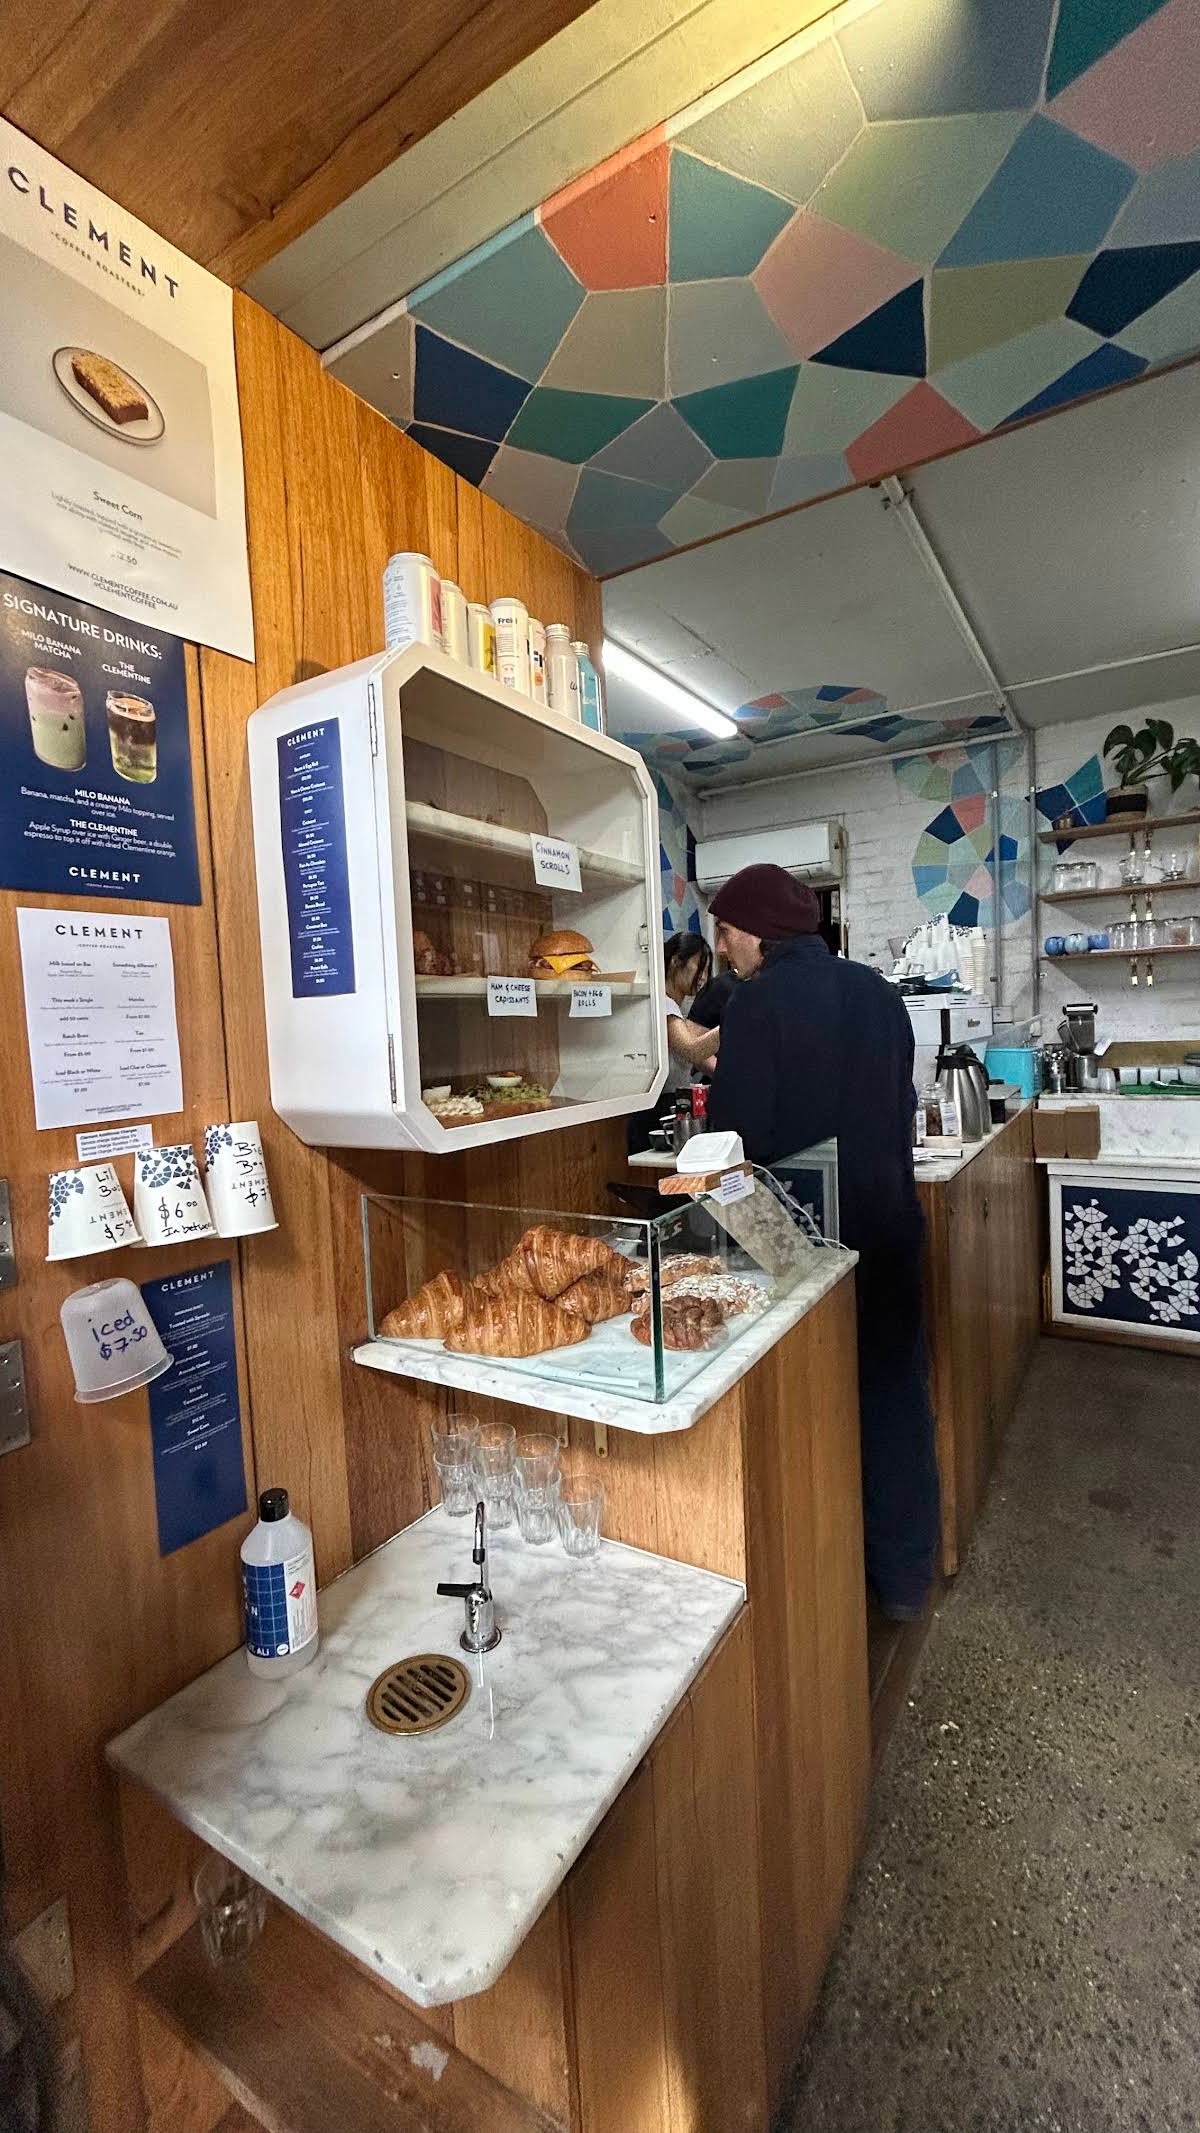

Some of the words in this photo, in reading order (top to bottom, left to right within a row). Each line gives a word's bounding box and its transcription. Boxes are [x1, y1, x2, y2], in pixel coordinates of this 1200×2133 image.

[8, 167, 179, 298] CLEMENT
[93, 491, 119, 511] Sweet
[121, 504, 143, 521] Corn
[3, 592, 101, 639] SIGNATURE
[103, 628, 162, 660] DRINKS:
[22, 629, 45, 643] MILO
[46, 636, 82, 656] BANANA
[34, 641, 72, 660] MATCHA
[102, 663, 151, 685] CLEMENTINE
[119, 661, 135, 672] THE
[287, 727, 325, 747] CLEMENT
[74, 788, 97, 800] MILO
[97, 791, 131, 806] BANANA
[77, 798, 89, 806] and
[95, 801, 117, 812] creamy
[91, 809, 106, 817] over
[29, 821, 51, 832] Apple
[51, 824, 71, 836] Syrup
[72, 829, 86, 837] over
[97, 832, 110, 840] with
[111, 833, 132, 845] Ginger
[69, 818, 88, 830] THE
[88, 821, 138, 837] CLEMENTINE
[24, 830, 54, 841] espresso
[55, 834, 63, 842] to
[63, 835, 75, 845] top
[81, 838, 91, 846] off
[91, 839, 105, 848] with
[105, 841, 121, 850] dried
[69, 866, 141, 884] CLEMENT
[540, 861, 570, 875] SCROLLS
[55, 924, 143, 940] CLEMENT
[491, 983, 503, 991] HAM
[511, 983, 531, 992] CHEESE
[161, 1226, 180, 1238] In
[161, 1270, 214, 1292] CLEMENT
[88, 1309, 135, 1342] iced
[100, 1325, 148, 1361] $7.50
